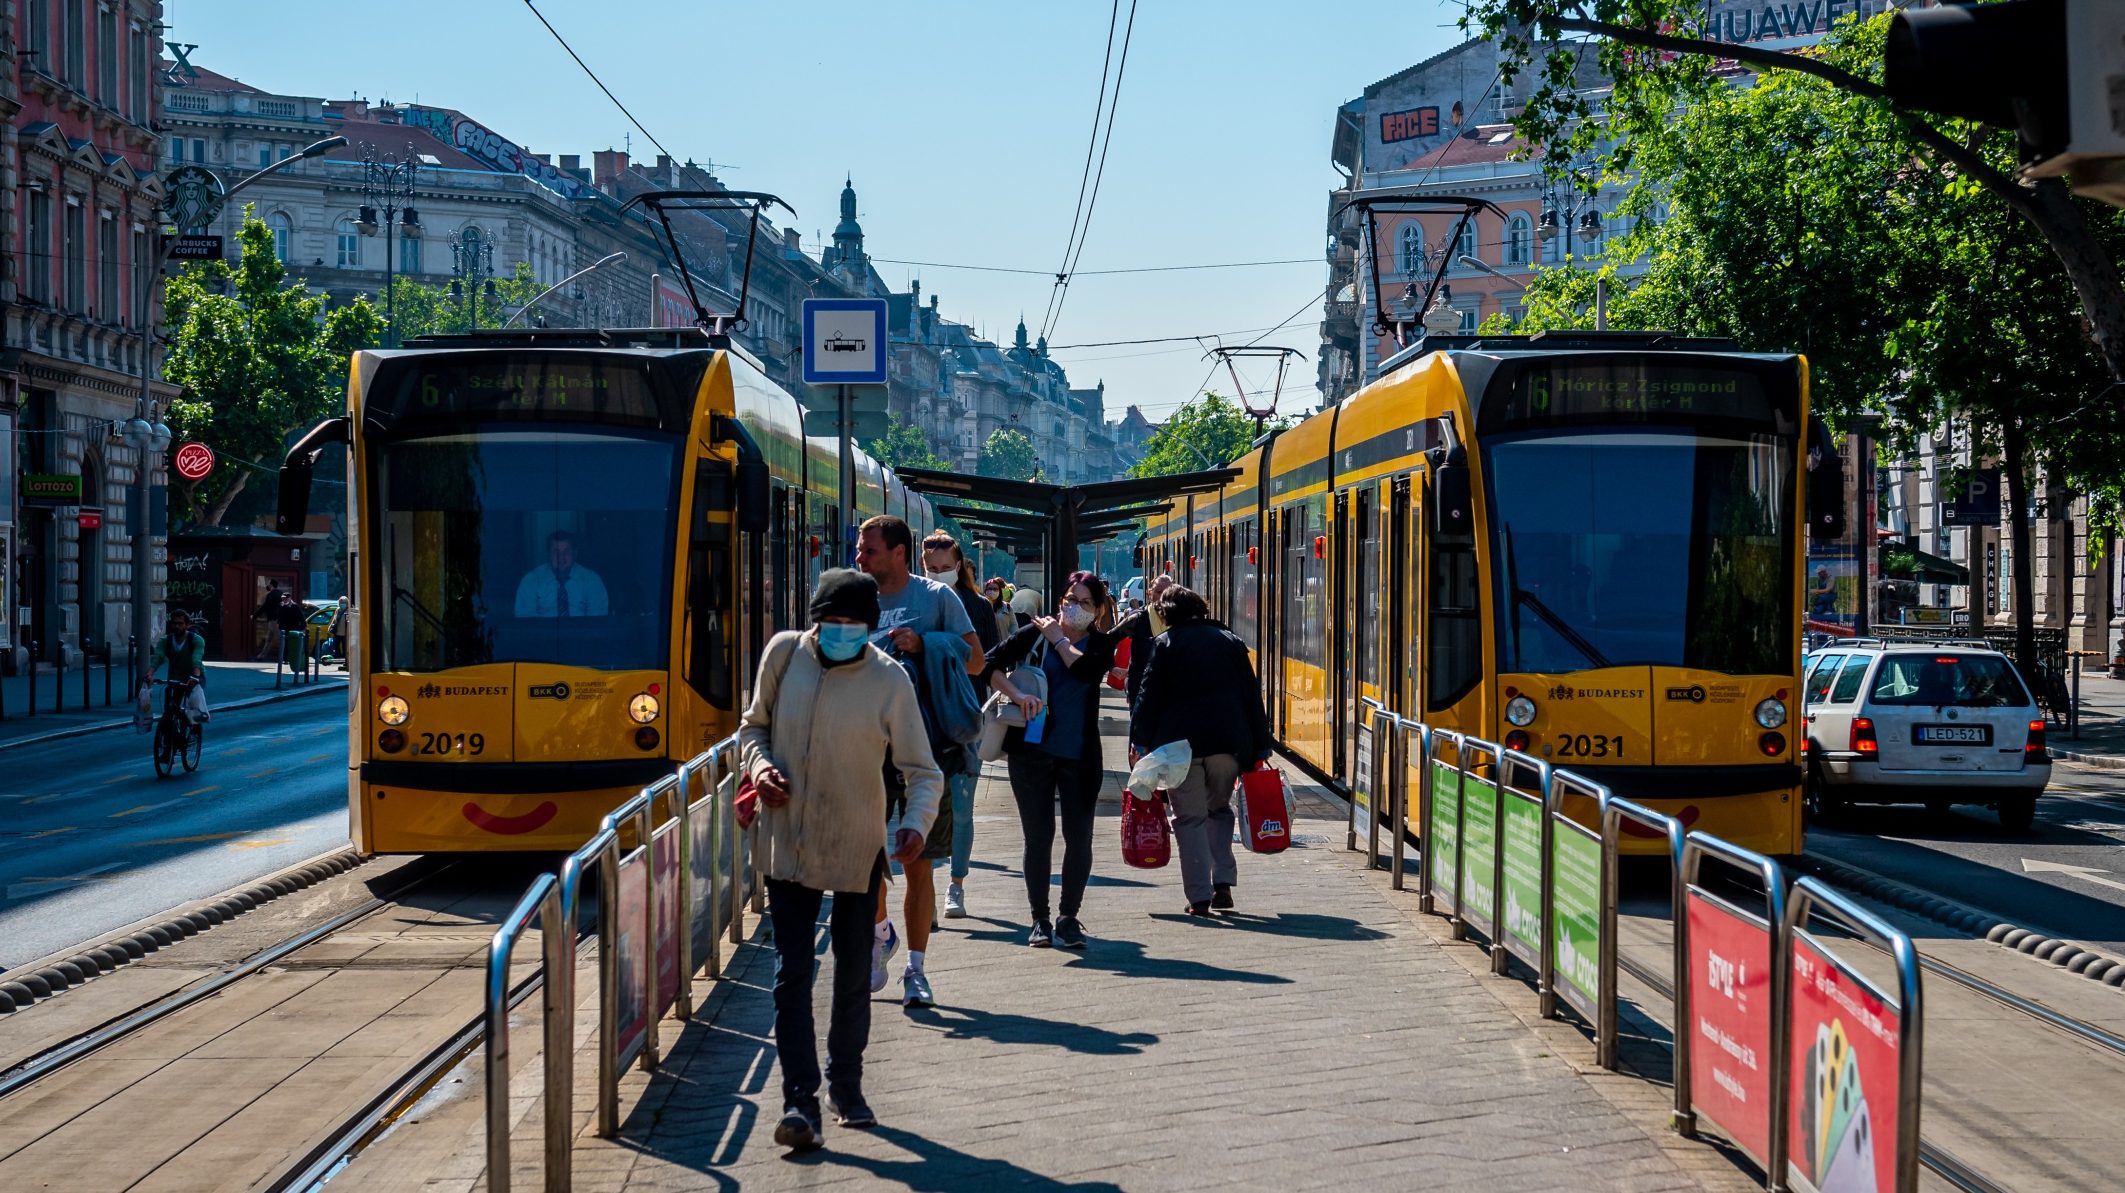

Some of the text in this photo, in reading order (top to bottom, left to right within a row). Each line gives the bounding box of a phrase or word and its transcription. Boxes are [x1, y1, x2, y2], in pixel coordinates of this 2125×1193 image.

[1705, 0, 1862, 43] HUAWEI
[165, 42, 200, 77] X
[1382, 109, 1437, 141] FACE
[457, 120, 519, 173] FACE
[175, 247, 208, 255] COFFEE
[421, 374, 439, 406] 6
[1532, 377, 1549, 410] 6
[1637, 379, 1736, 394] Zsigmond
[1968, 481, 1988, 504] P
[1987, 550, 1995, 608] CHANGE
[445, 686, 509, 696] BUDAPEST
[533, 688, 552, 696] BKK
[1578, 689, 1645, 699] BUDAPEST
[1671, 690, 1689, 698] BKK
[420, 732, 485, 756] 2019
[1557, 733, 1624, 758] 2031
[1926, 728, 1983, 741] LED-521
[1261, 819, 1281, 832] dm
